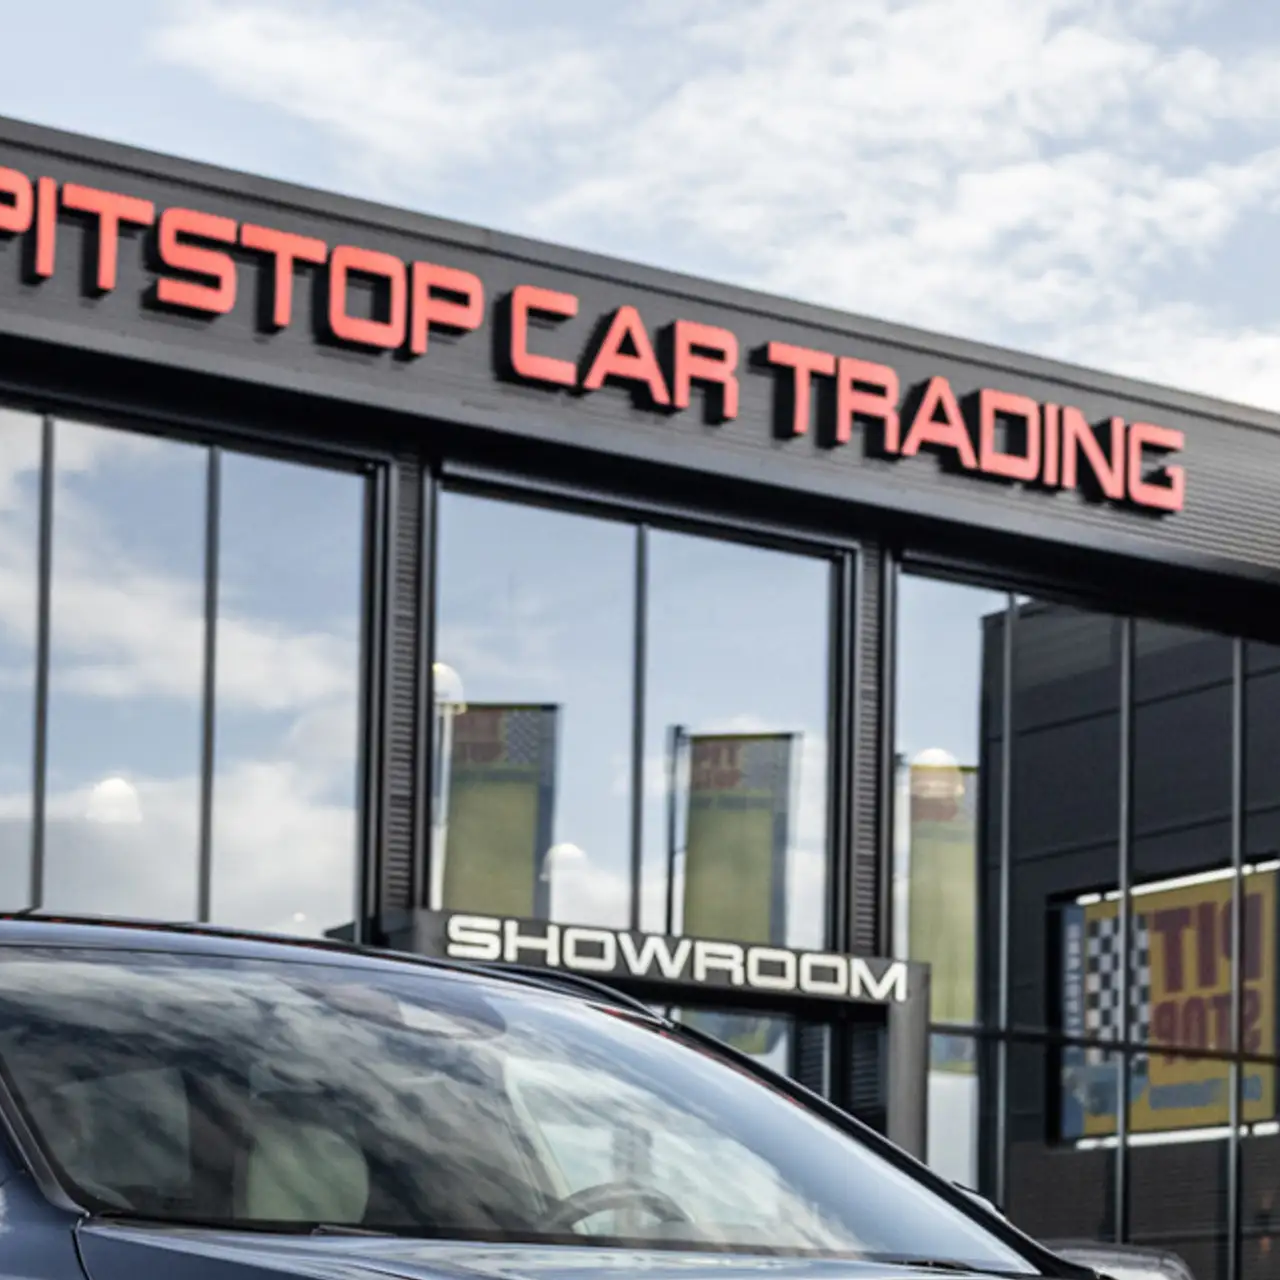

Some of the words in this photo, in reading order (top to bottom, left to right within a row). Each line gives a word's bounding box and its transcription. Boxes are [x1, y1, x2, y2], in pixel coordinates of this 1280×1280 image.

[508, 284, 740, 420] CAR
[765, 340, 1186, 512] TRADING
[447, 914, 909, 1002] SHOWROOM
